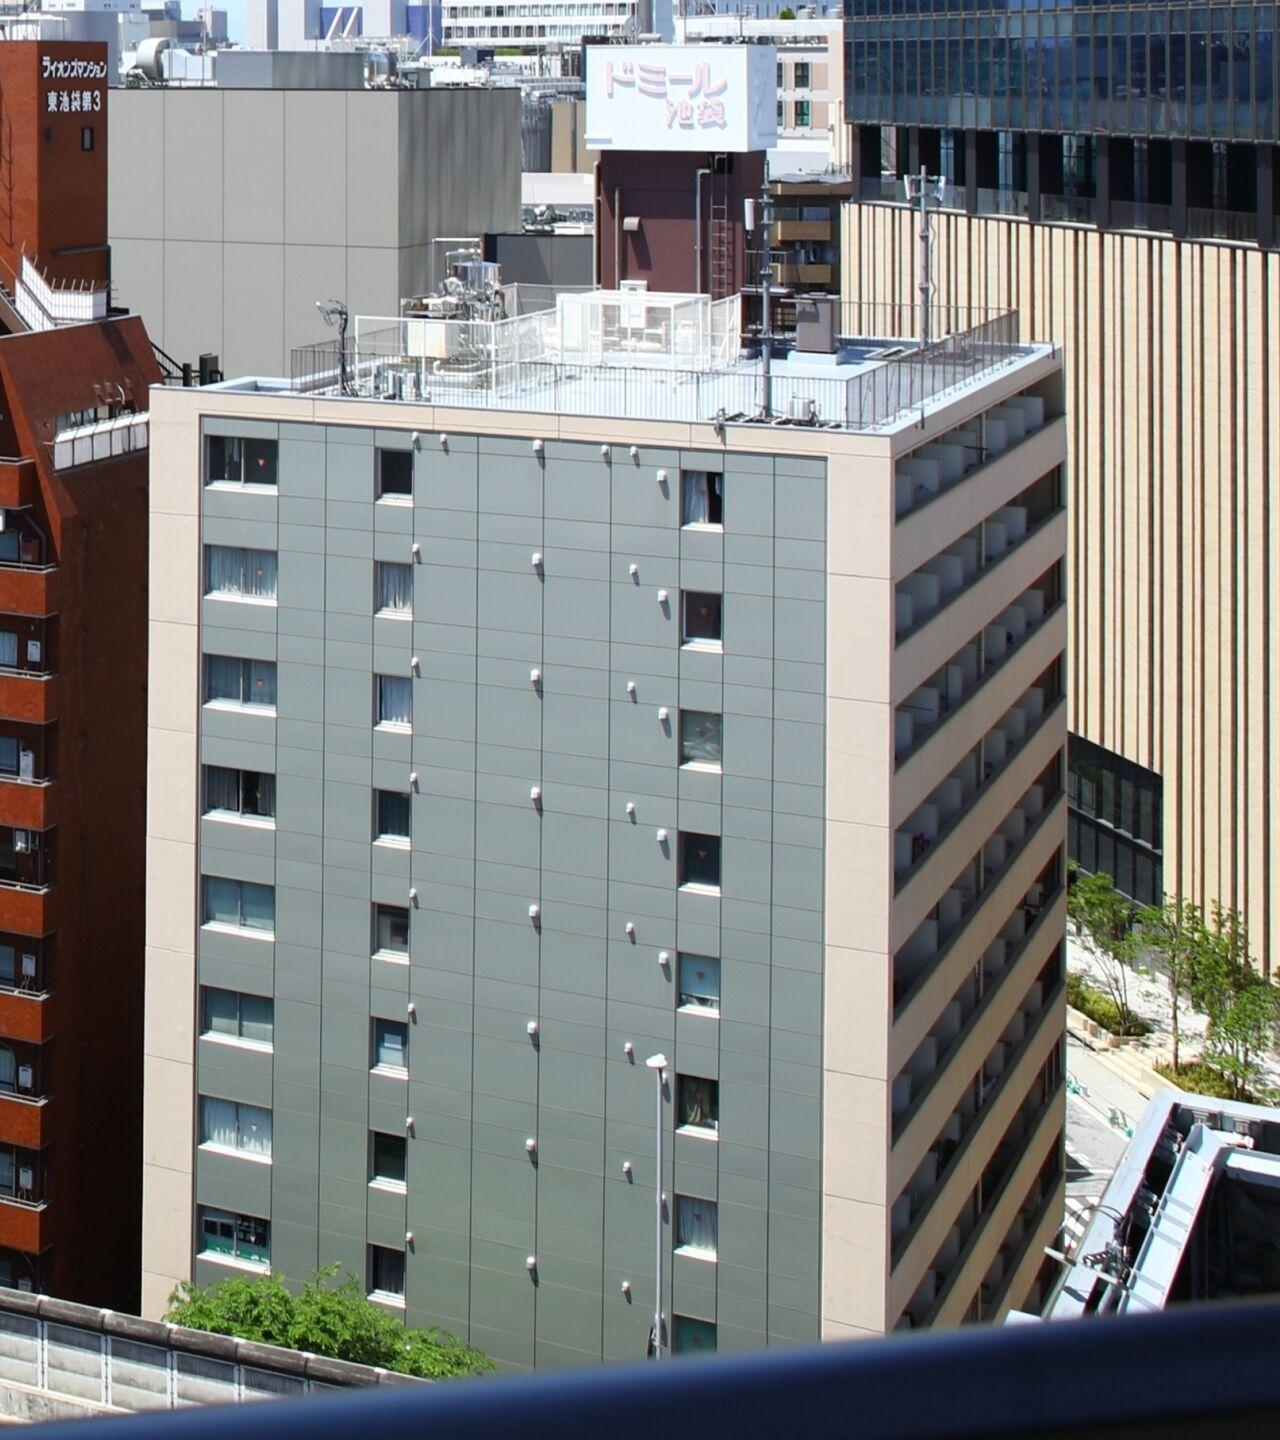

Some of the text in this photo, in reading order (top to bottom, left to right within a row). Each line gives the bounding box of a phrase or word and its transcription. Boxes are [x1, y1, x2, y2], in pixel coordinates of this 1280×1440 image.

[42, 56, 107, 78] ライオンズマンション
[606, 61, 728, 99] ドミール
[47, 90, 101, 112] 東池袋第3
[665, 99, 728, 130] 池袋
